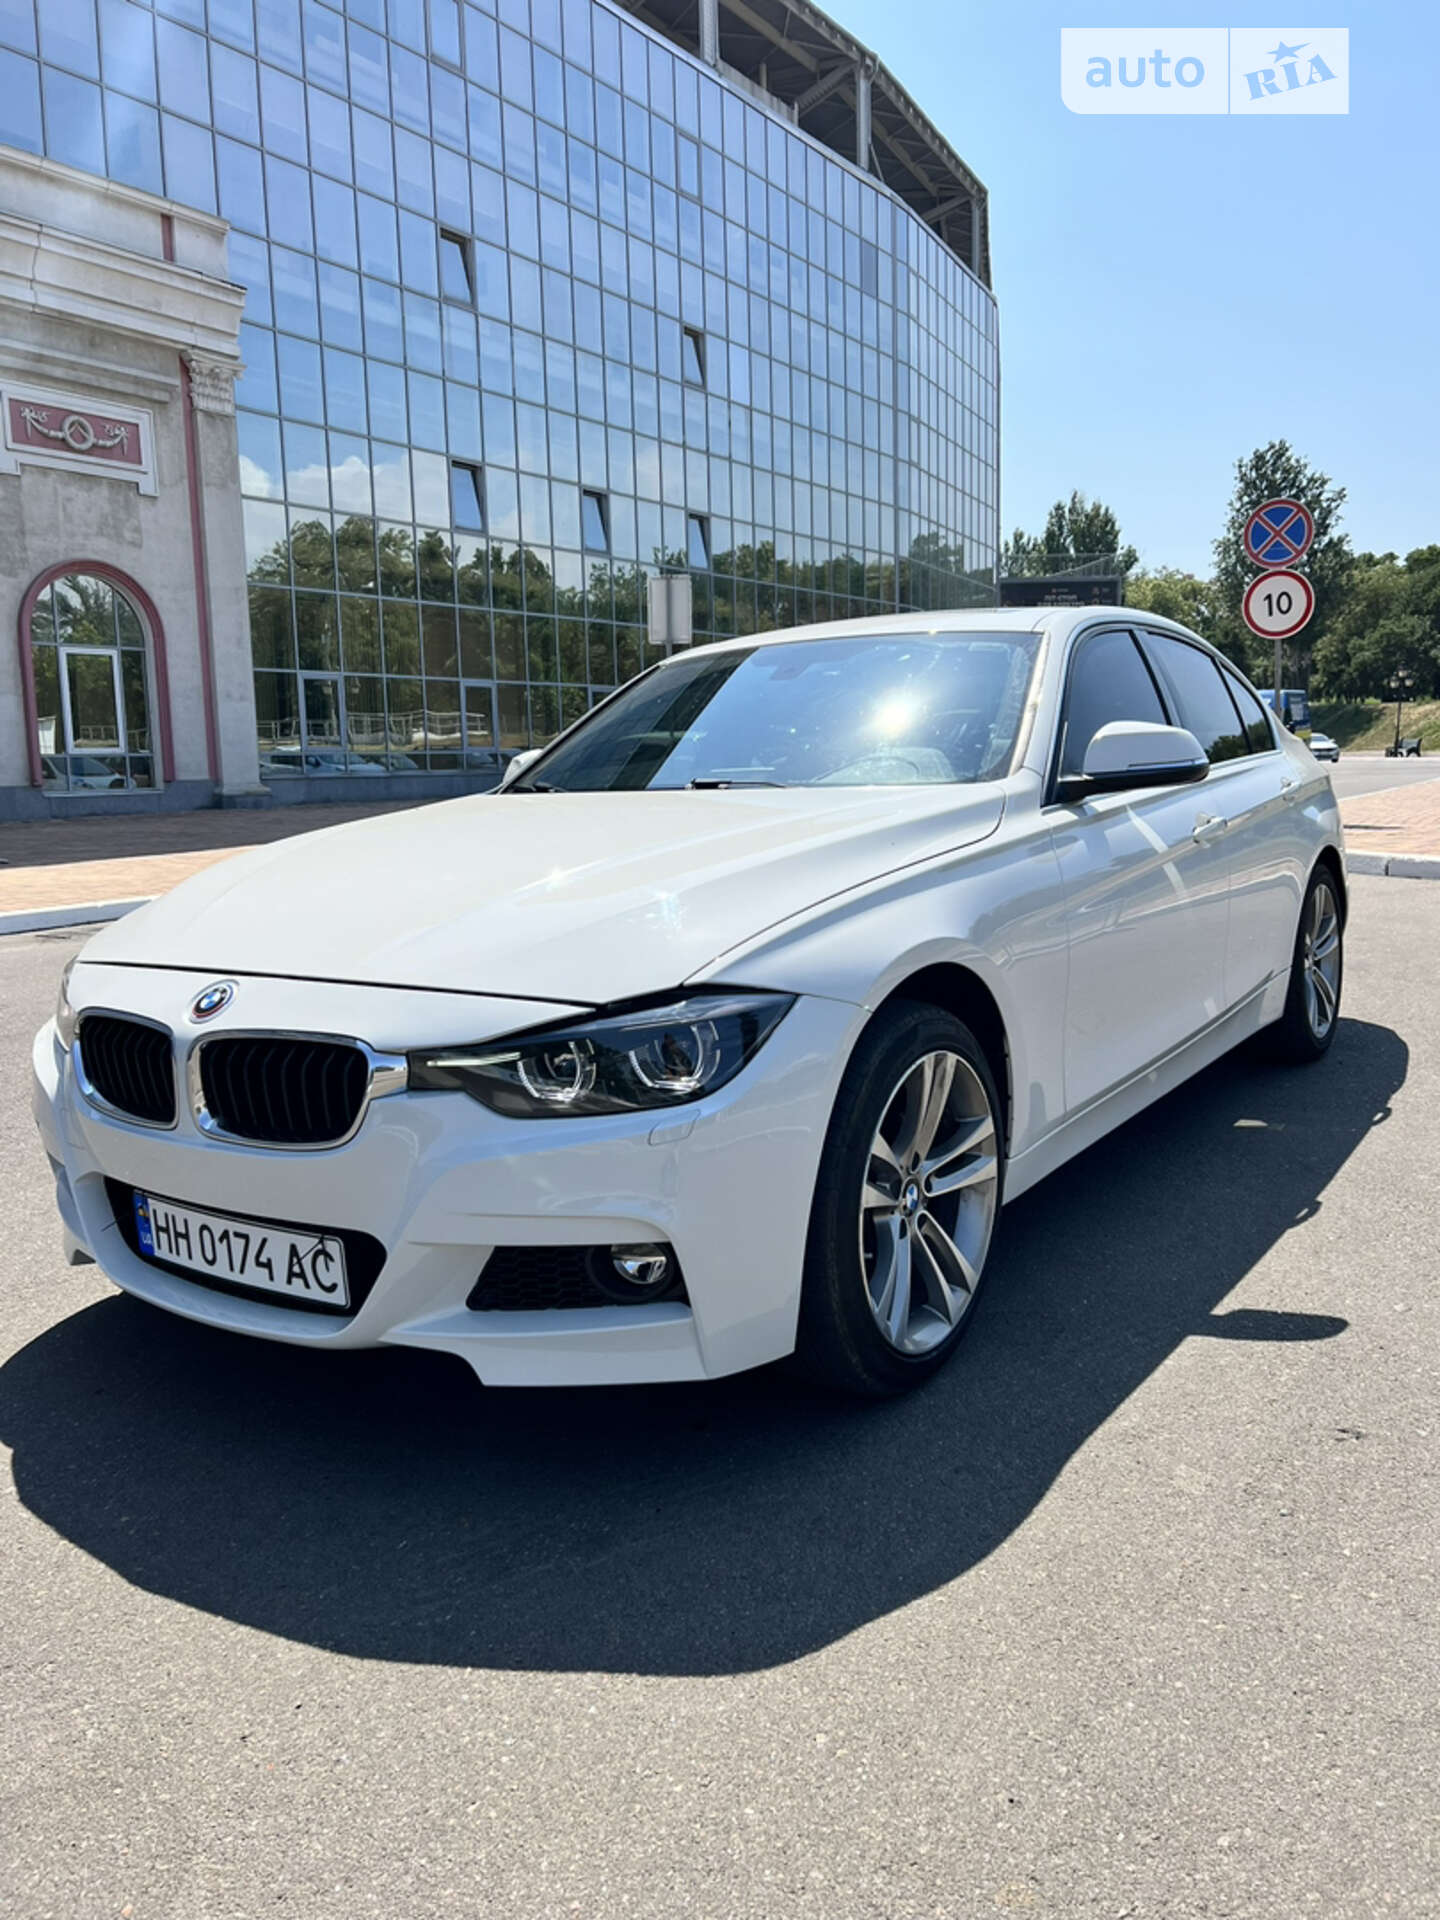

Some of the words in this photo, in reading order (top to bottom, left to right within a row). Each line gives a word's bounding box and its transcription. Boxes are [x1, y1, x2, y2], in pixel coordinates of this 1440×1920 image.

[1263, 591, 1292, 617] 10
[152, 1208, 193, 1260] HH
[199, 1223, 274, 1282] 0174
[286, 1243, 338, 1293] AC
